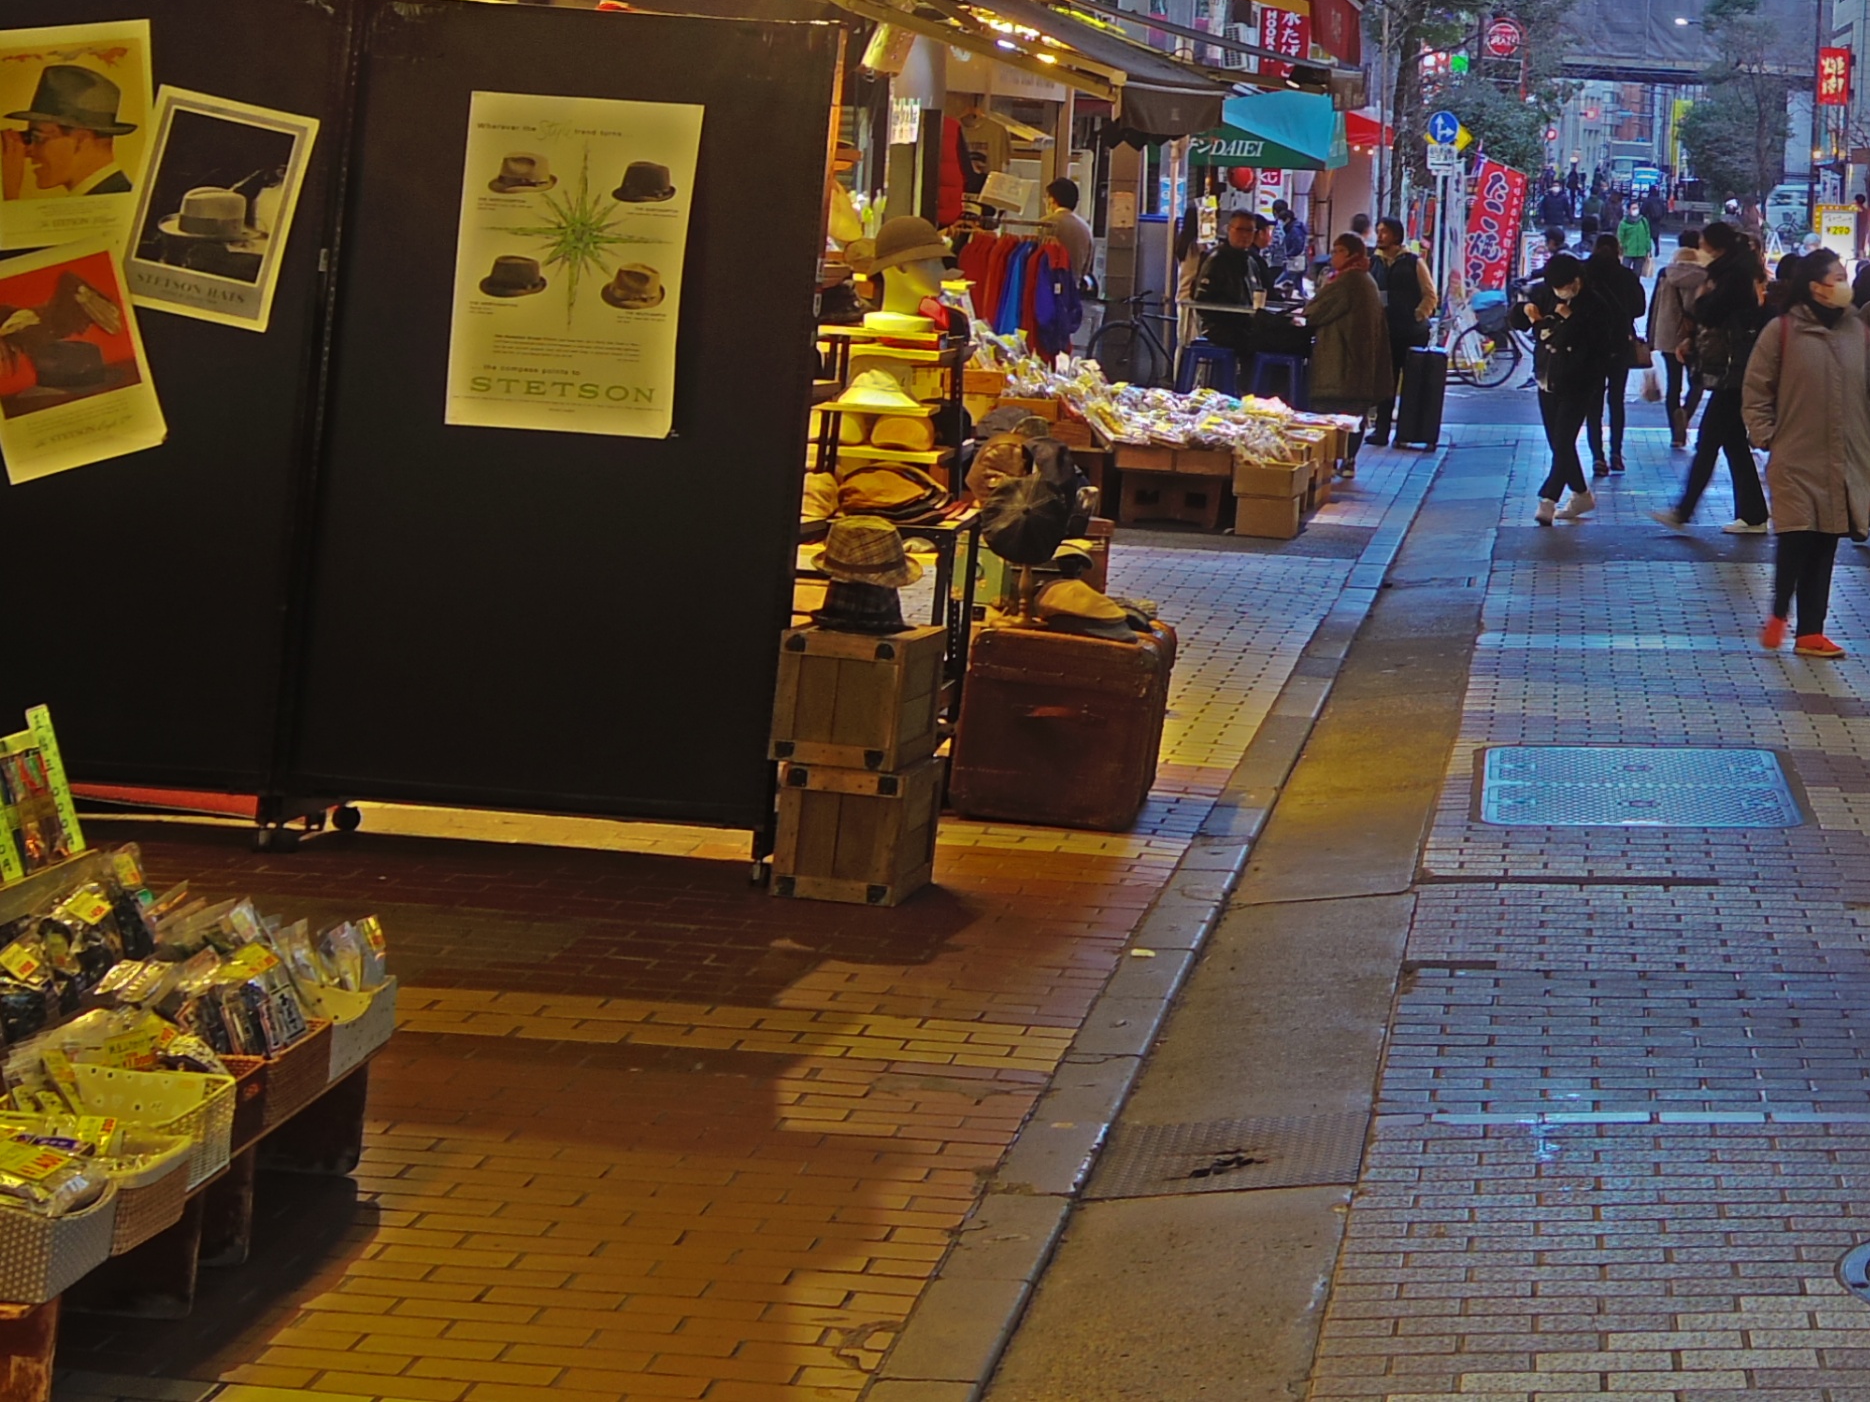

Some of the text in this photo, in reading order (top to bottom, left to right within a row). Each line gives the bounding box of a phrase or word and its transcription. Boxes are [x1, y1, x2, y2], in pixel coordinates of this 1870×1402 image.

[1210, 139, 1265, 157] DAIEI
[136, 272, 201, 295] STETSON
[470, 376, 656, 404] STETSON
